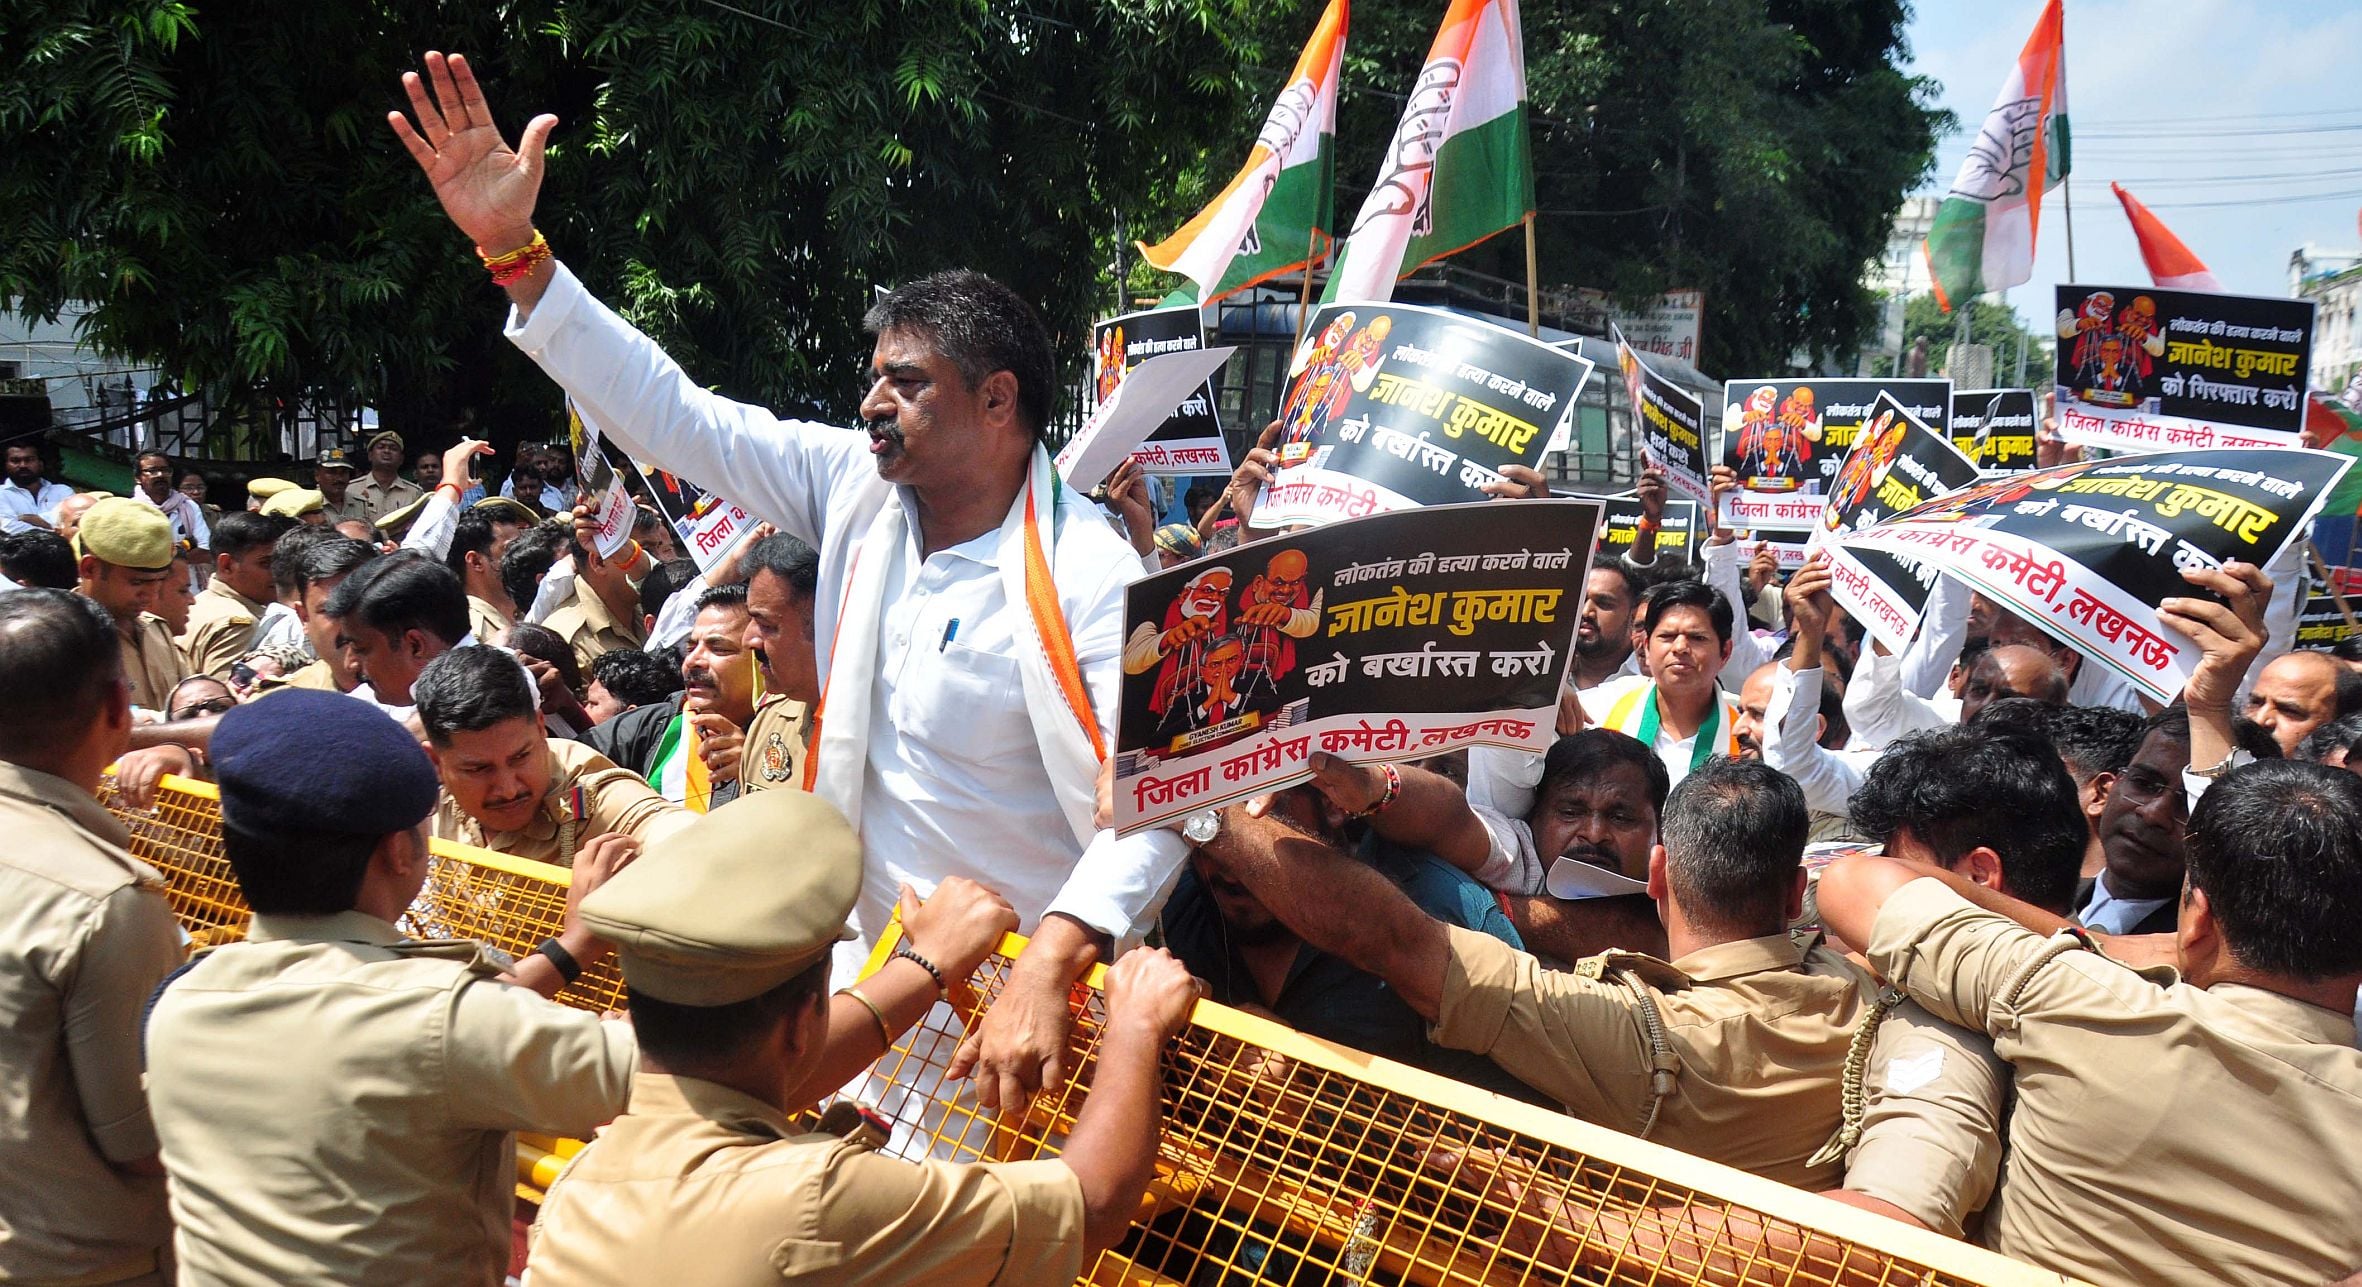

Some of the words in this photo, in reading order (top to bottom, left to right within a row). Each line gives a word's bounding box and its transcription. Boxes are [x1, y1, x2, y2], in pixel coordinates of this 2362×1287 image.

[2167, 338, 2233, 368] ज्ञानेश
[2233, 351, 2299, 378] कुमार
[1181, 392, 1208, 417] करो
[1488, 371, 1526, 399] करने
[1523, 388, 1556, 412] वाले
[2161, 371, 2185, 397] को
[2261, 384, 2299, 412] करो
[1369, 373, 1456, 420] ज्ञानेश
[1443, 396, 1539, 455] कुमार
[2064, 408, 2105, 433] जिला
[2110, 416, 2161, 442] कांग्रेस
[1339, 413, 1370, 444] को
[1372, 425, 1458, 476] बर्खास्त
[1819, 453, 1841, 477] को
[1730, 498, 1769, 517] जिला
[1775, 496, 1821, 519] कांग्रेस
[2013, 497, 2060, 516] को
[2060, 502, 2174, 557] बर्खास्त
[2057, 475, 2168, 502] ज्ञानेश
[2155, 482, 2280, 545] कुमार
[697, 516, 734, 556] जिला
[1897, 528, 1980, 556] कांग्रेस
[1334, 557, 1404, 588] लोकतंत्र
[1407, 555, 1433, 576] की
[1437, 556, 1479, 575] हत्या
[1482, 548, 1530, 571] करने
[1533, 546, 1573, 571] वाले
[1327, 586, 1449, 638] ज्ञानेश
[1452, 588, 1563, 636] कुमार
[1305, 652, 1350, 688] को
[1361, 641, 1481, 681] बर्खास्त
[1489, 640, 1555, 676] करो
[1188, 726, 1219, 741] GYANESH
[1219, 718, 1243, 731] KUMAR
[1134, 771, 1211, 812] जिला
[1221, 734, 1311, 784] कांग्रेस
